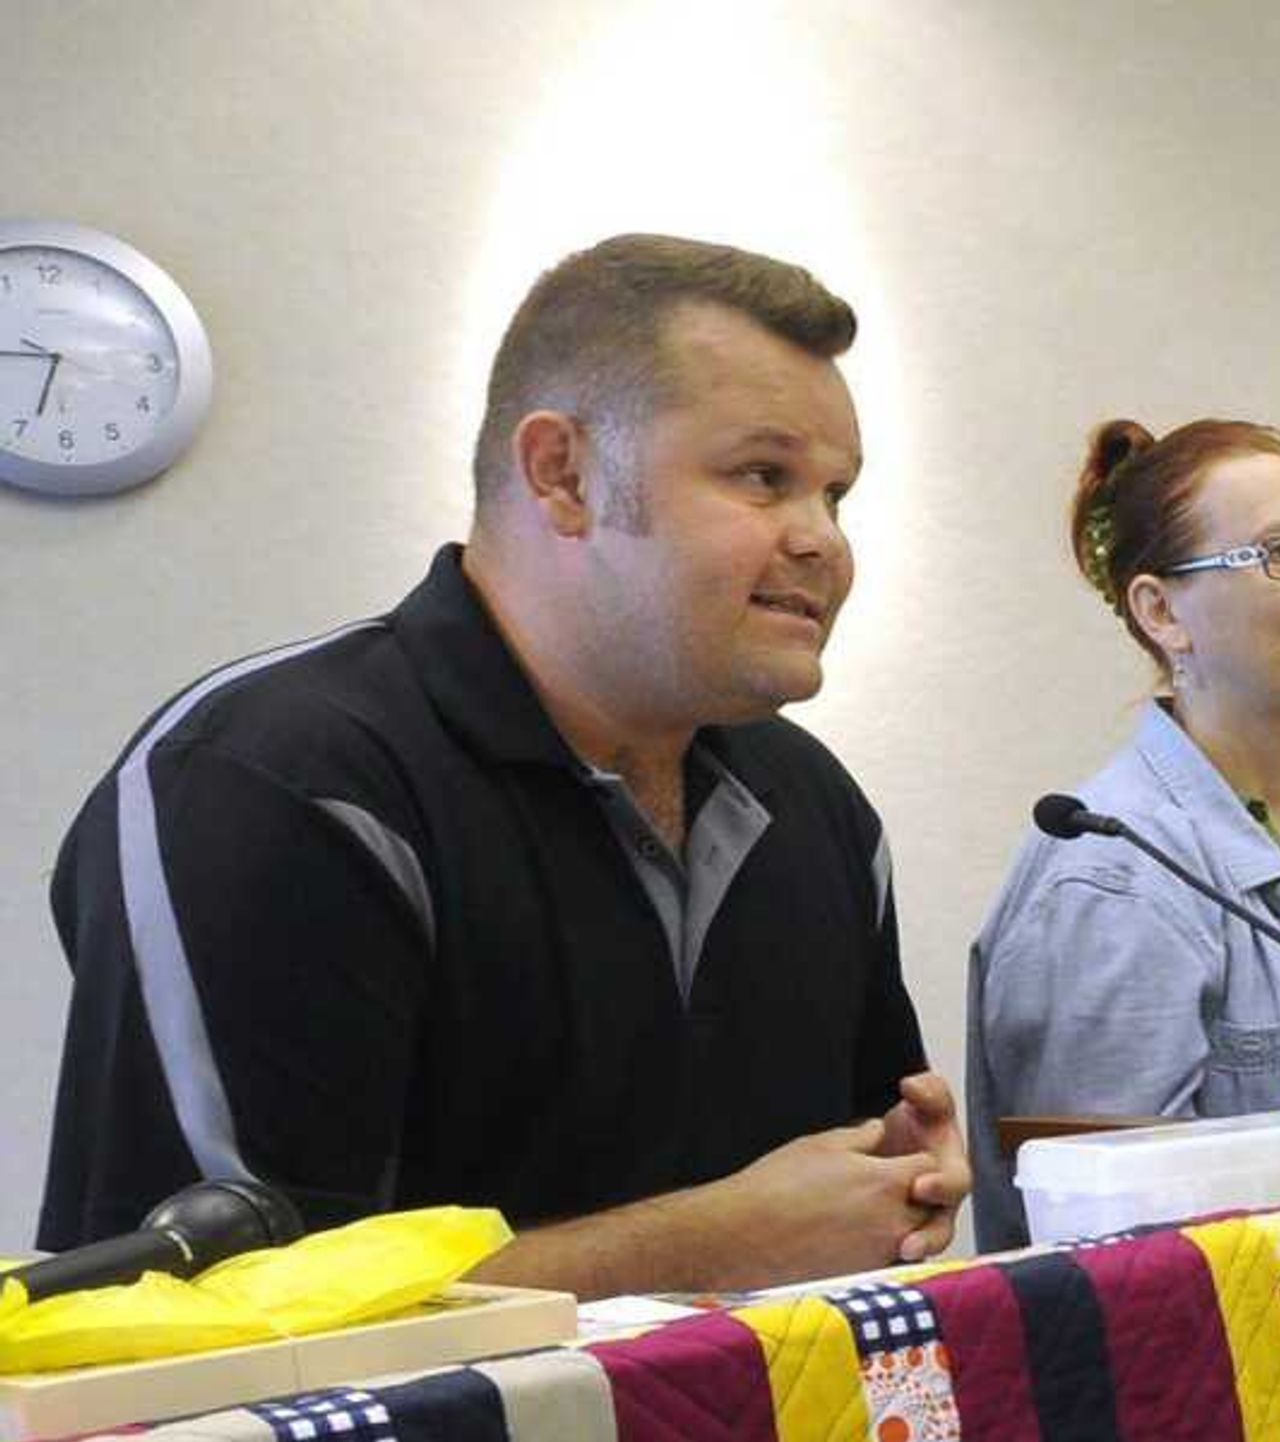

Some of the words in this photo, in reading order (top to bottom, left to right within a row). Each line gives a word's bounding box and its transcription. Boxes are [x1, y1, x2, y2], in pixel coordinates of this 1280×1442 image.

[36, 264, 61, 284] 12
[148, 353, 162, 373] 3
[136, 396, 150, 413] 4
[13, 420, 28, 437] 7
[104, 423, 120, 441] 5
[58, 430, 74, 449] 6
